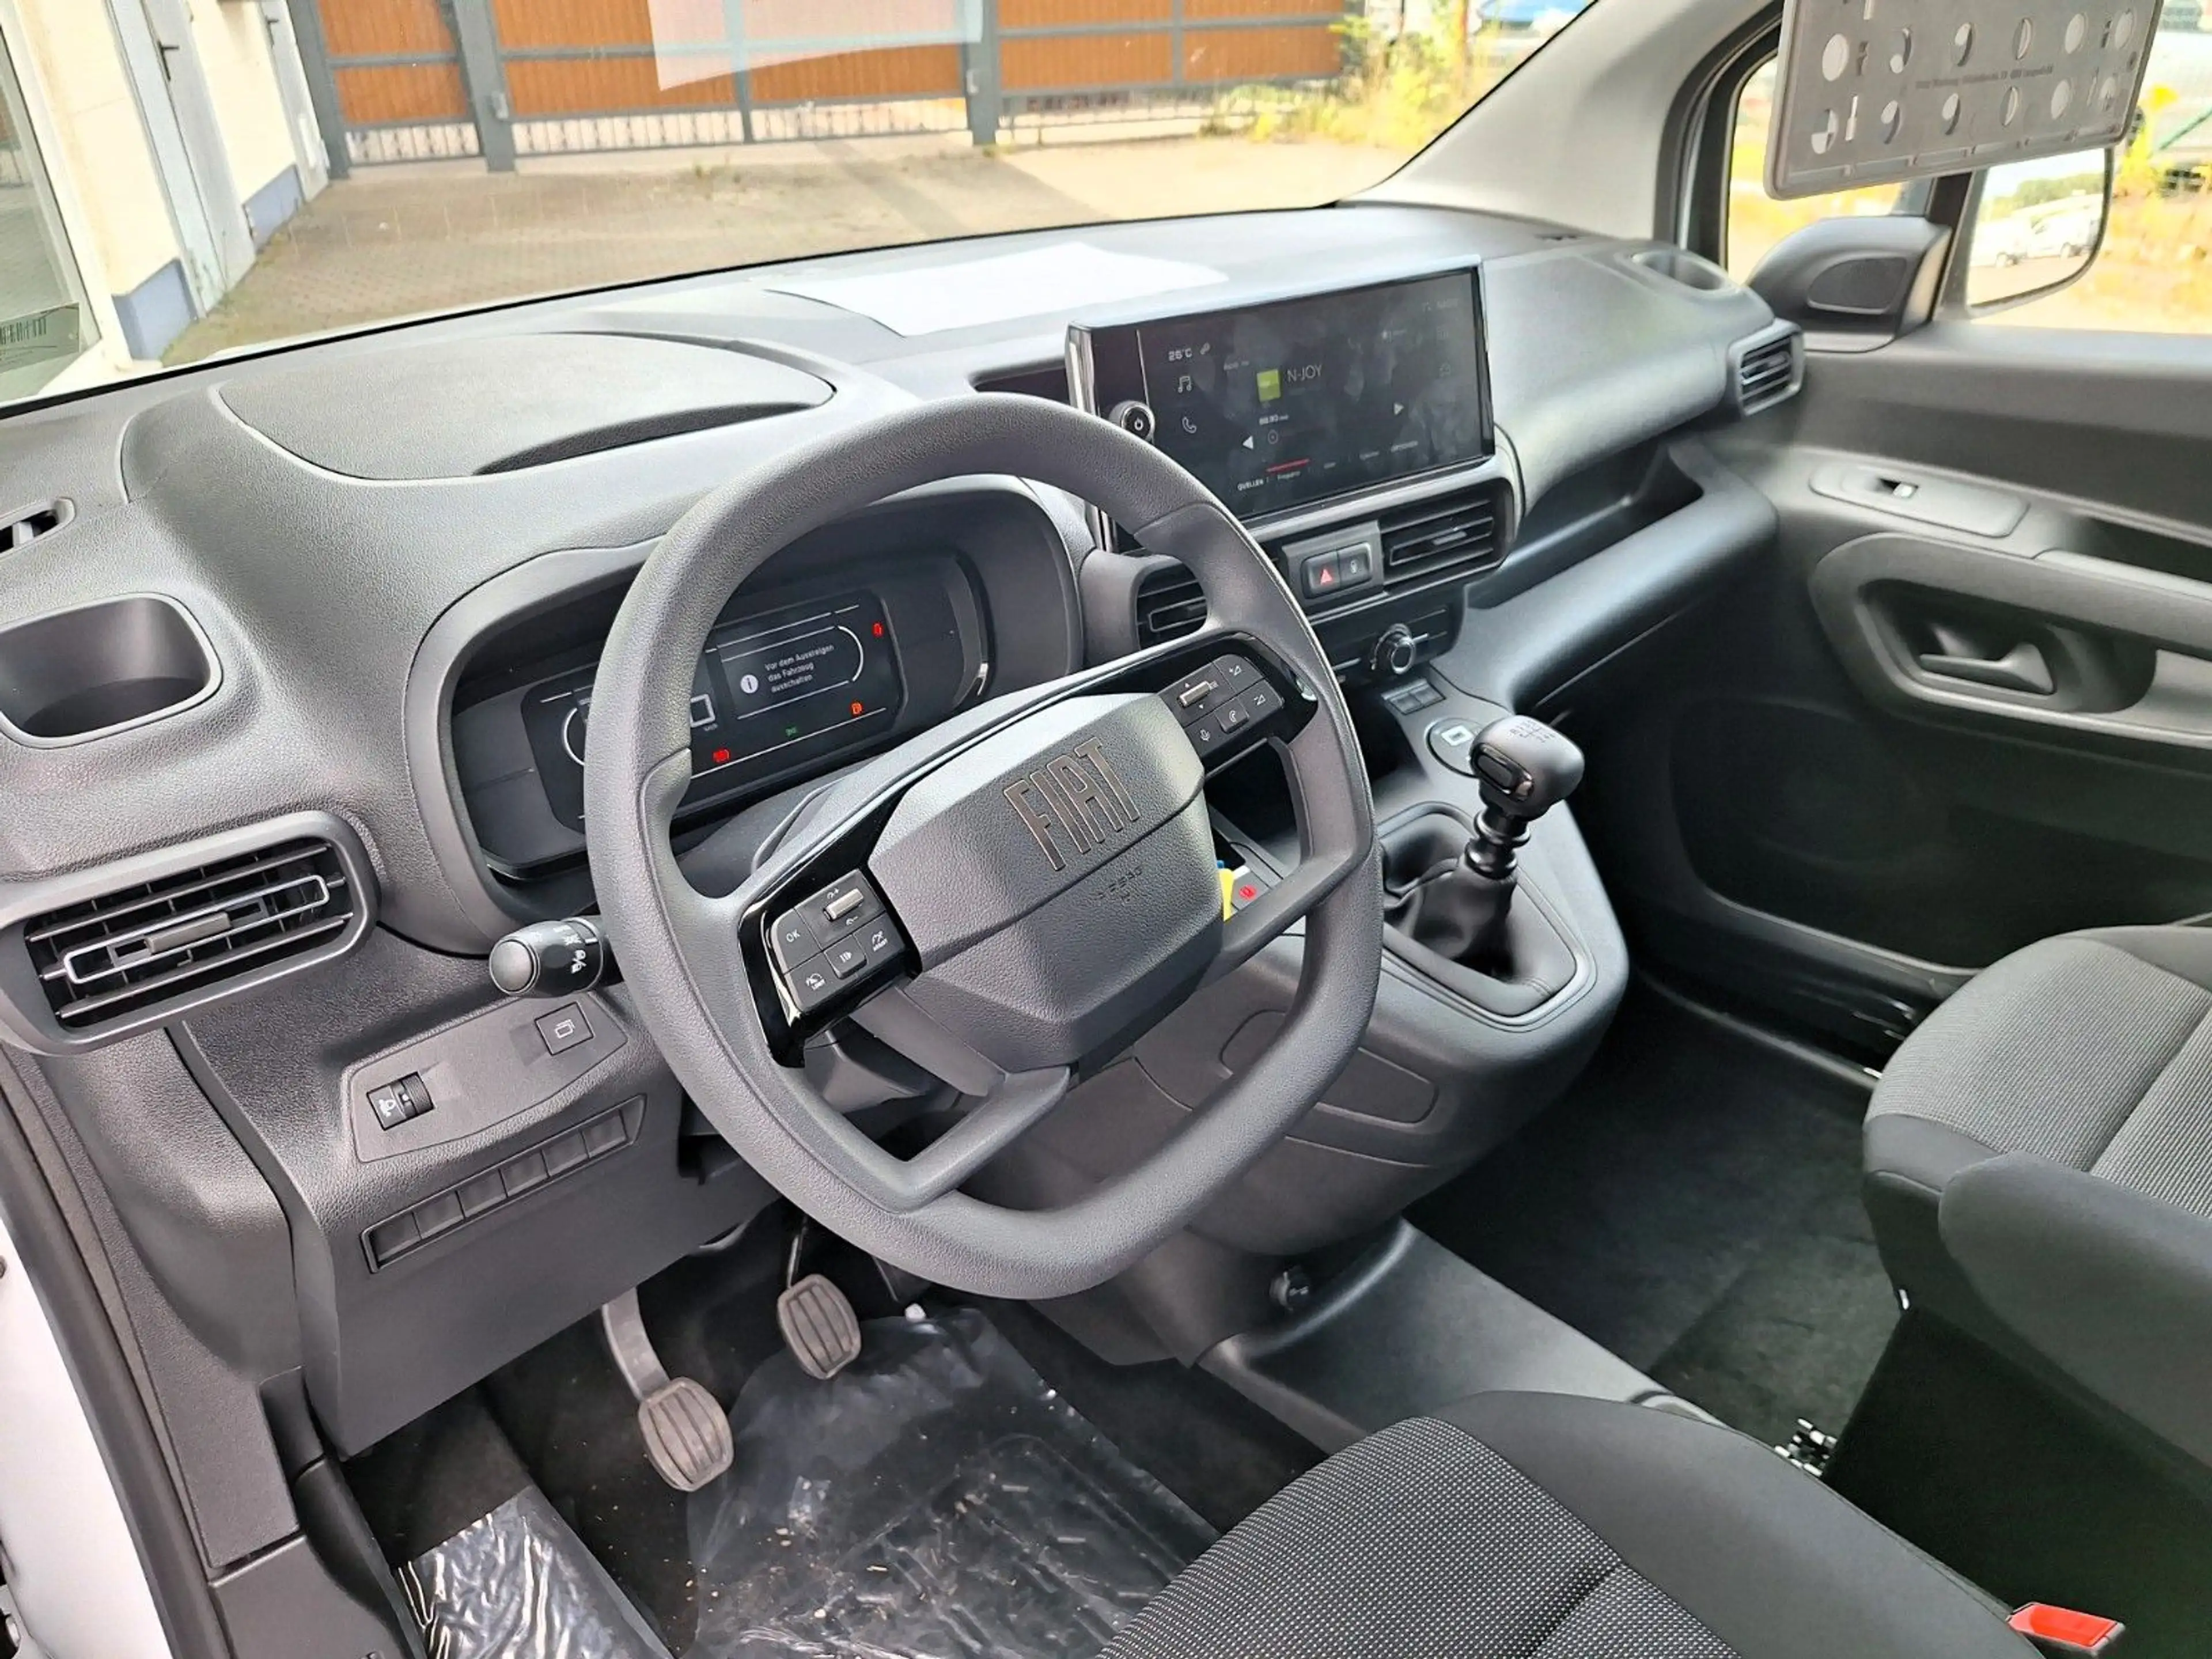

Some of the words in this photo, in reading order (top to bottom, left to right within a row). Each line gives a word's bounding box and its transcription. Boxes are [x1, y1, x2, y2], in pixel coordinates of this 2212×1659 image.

[1286, 364, 1323, 382] N-JOY
[764, 662, 778, 671] Vor
[779, 657, 794, 667] dem
[768, 672, 782, 682] das
[1003, 737, 1141, 872] FIAT
[785, 930, 801, 943] OK
